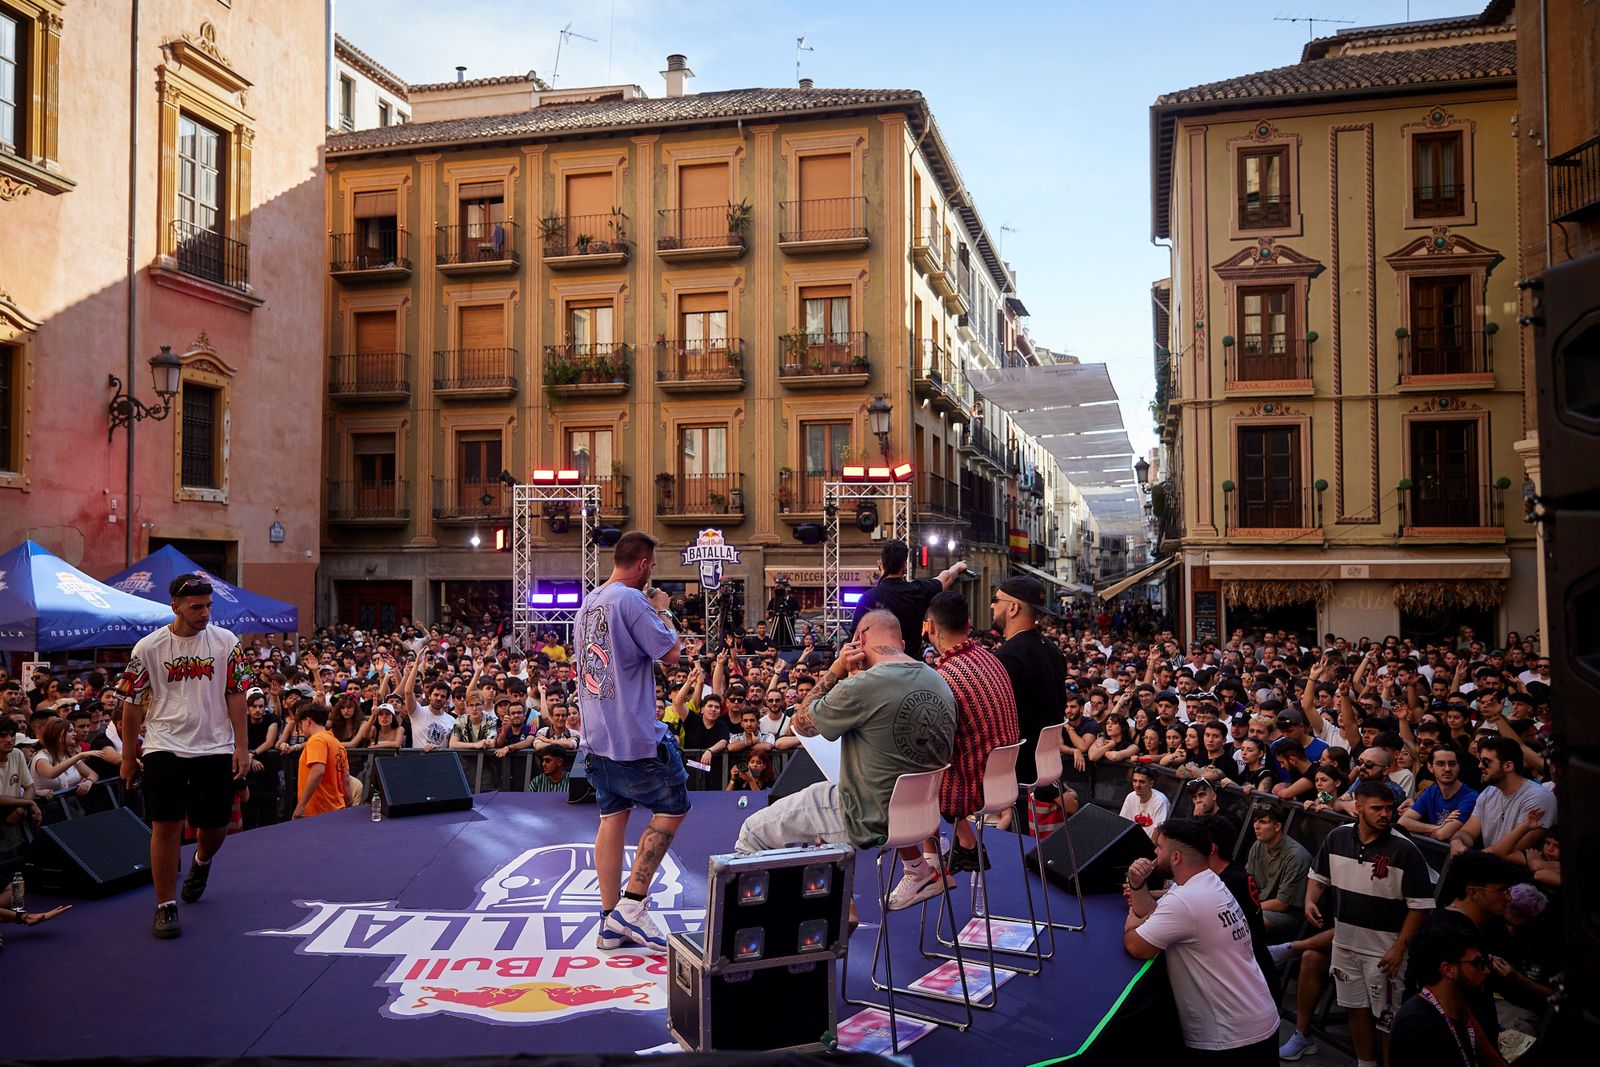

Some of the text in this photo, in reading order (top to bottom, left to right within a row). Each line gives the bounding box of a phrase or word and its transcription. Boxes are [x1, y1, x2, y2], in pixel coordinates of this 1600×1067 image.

[689, 546, 732, 560] BATALLA
[839, 572, 860, 582] RUIZ
[164, 656, 214, 683] KING
[900, 692, 949, 720] HYDROPONIC
[406, 954, 668, 981] Red Bull
